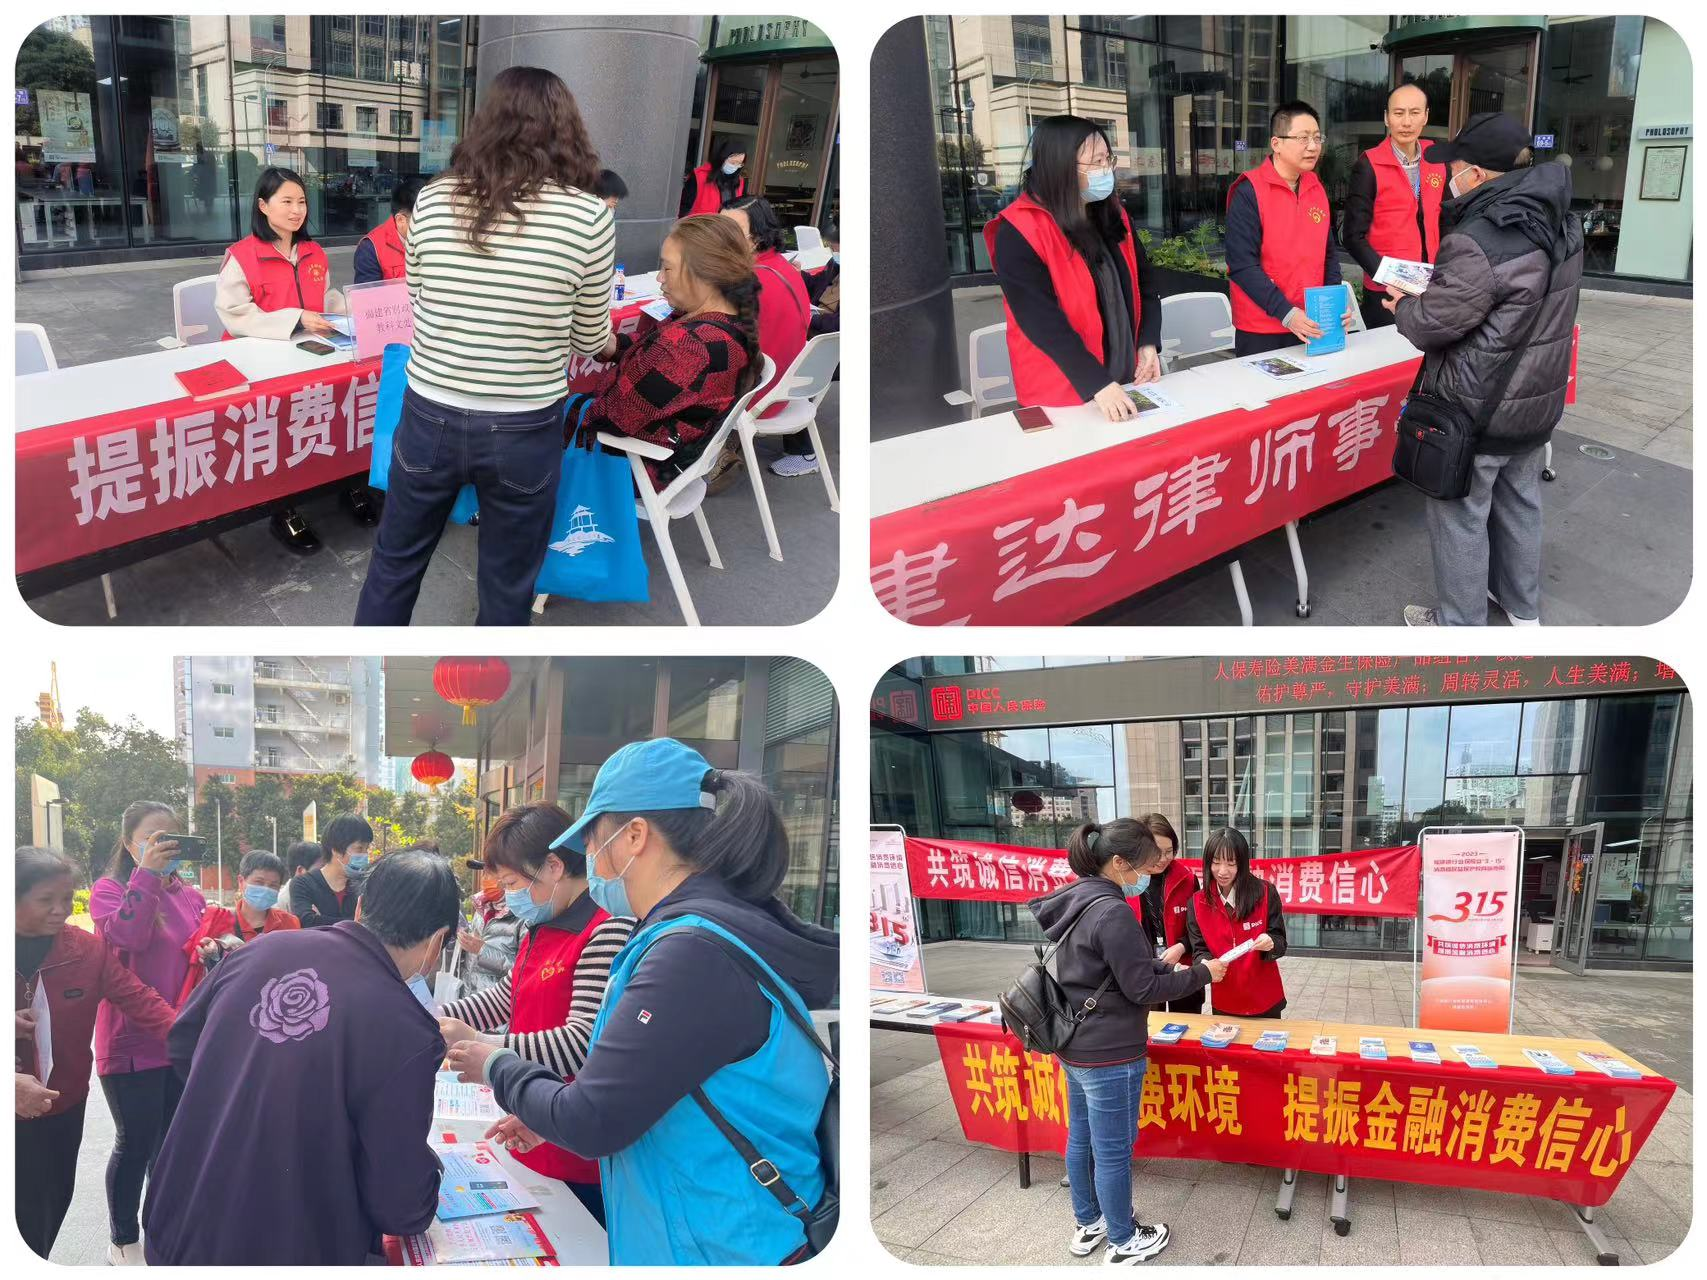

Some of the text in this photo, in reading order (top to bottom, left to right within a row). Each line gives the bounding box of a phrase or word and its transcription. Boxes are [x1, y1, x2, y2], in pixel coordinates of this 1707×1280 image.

[1645, 127, 1689, 136] PHOLOSOPHY
[67, 372, 381, 526] 提振消费信
[870, 393, 1391, 626] 建达律师事
[966, 688, 1000, 700] PICC
[967, 699, 1047, 714] 中国人民保险
[1428, 891, 1508, 923] 315
[962, 1043, 1243, 1136] 共筑诚费环境
[1283, 1073, 1633, 1177] 提振金融消费信心
